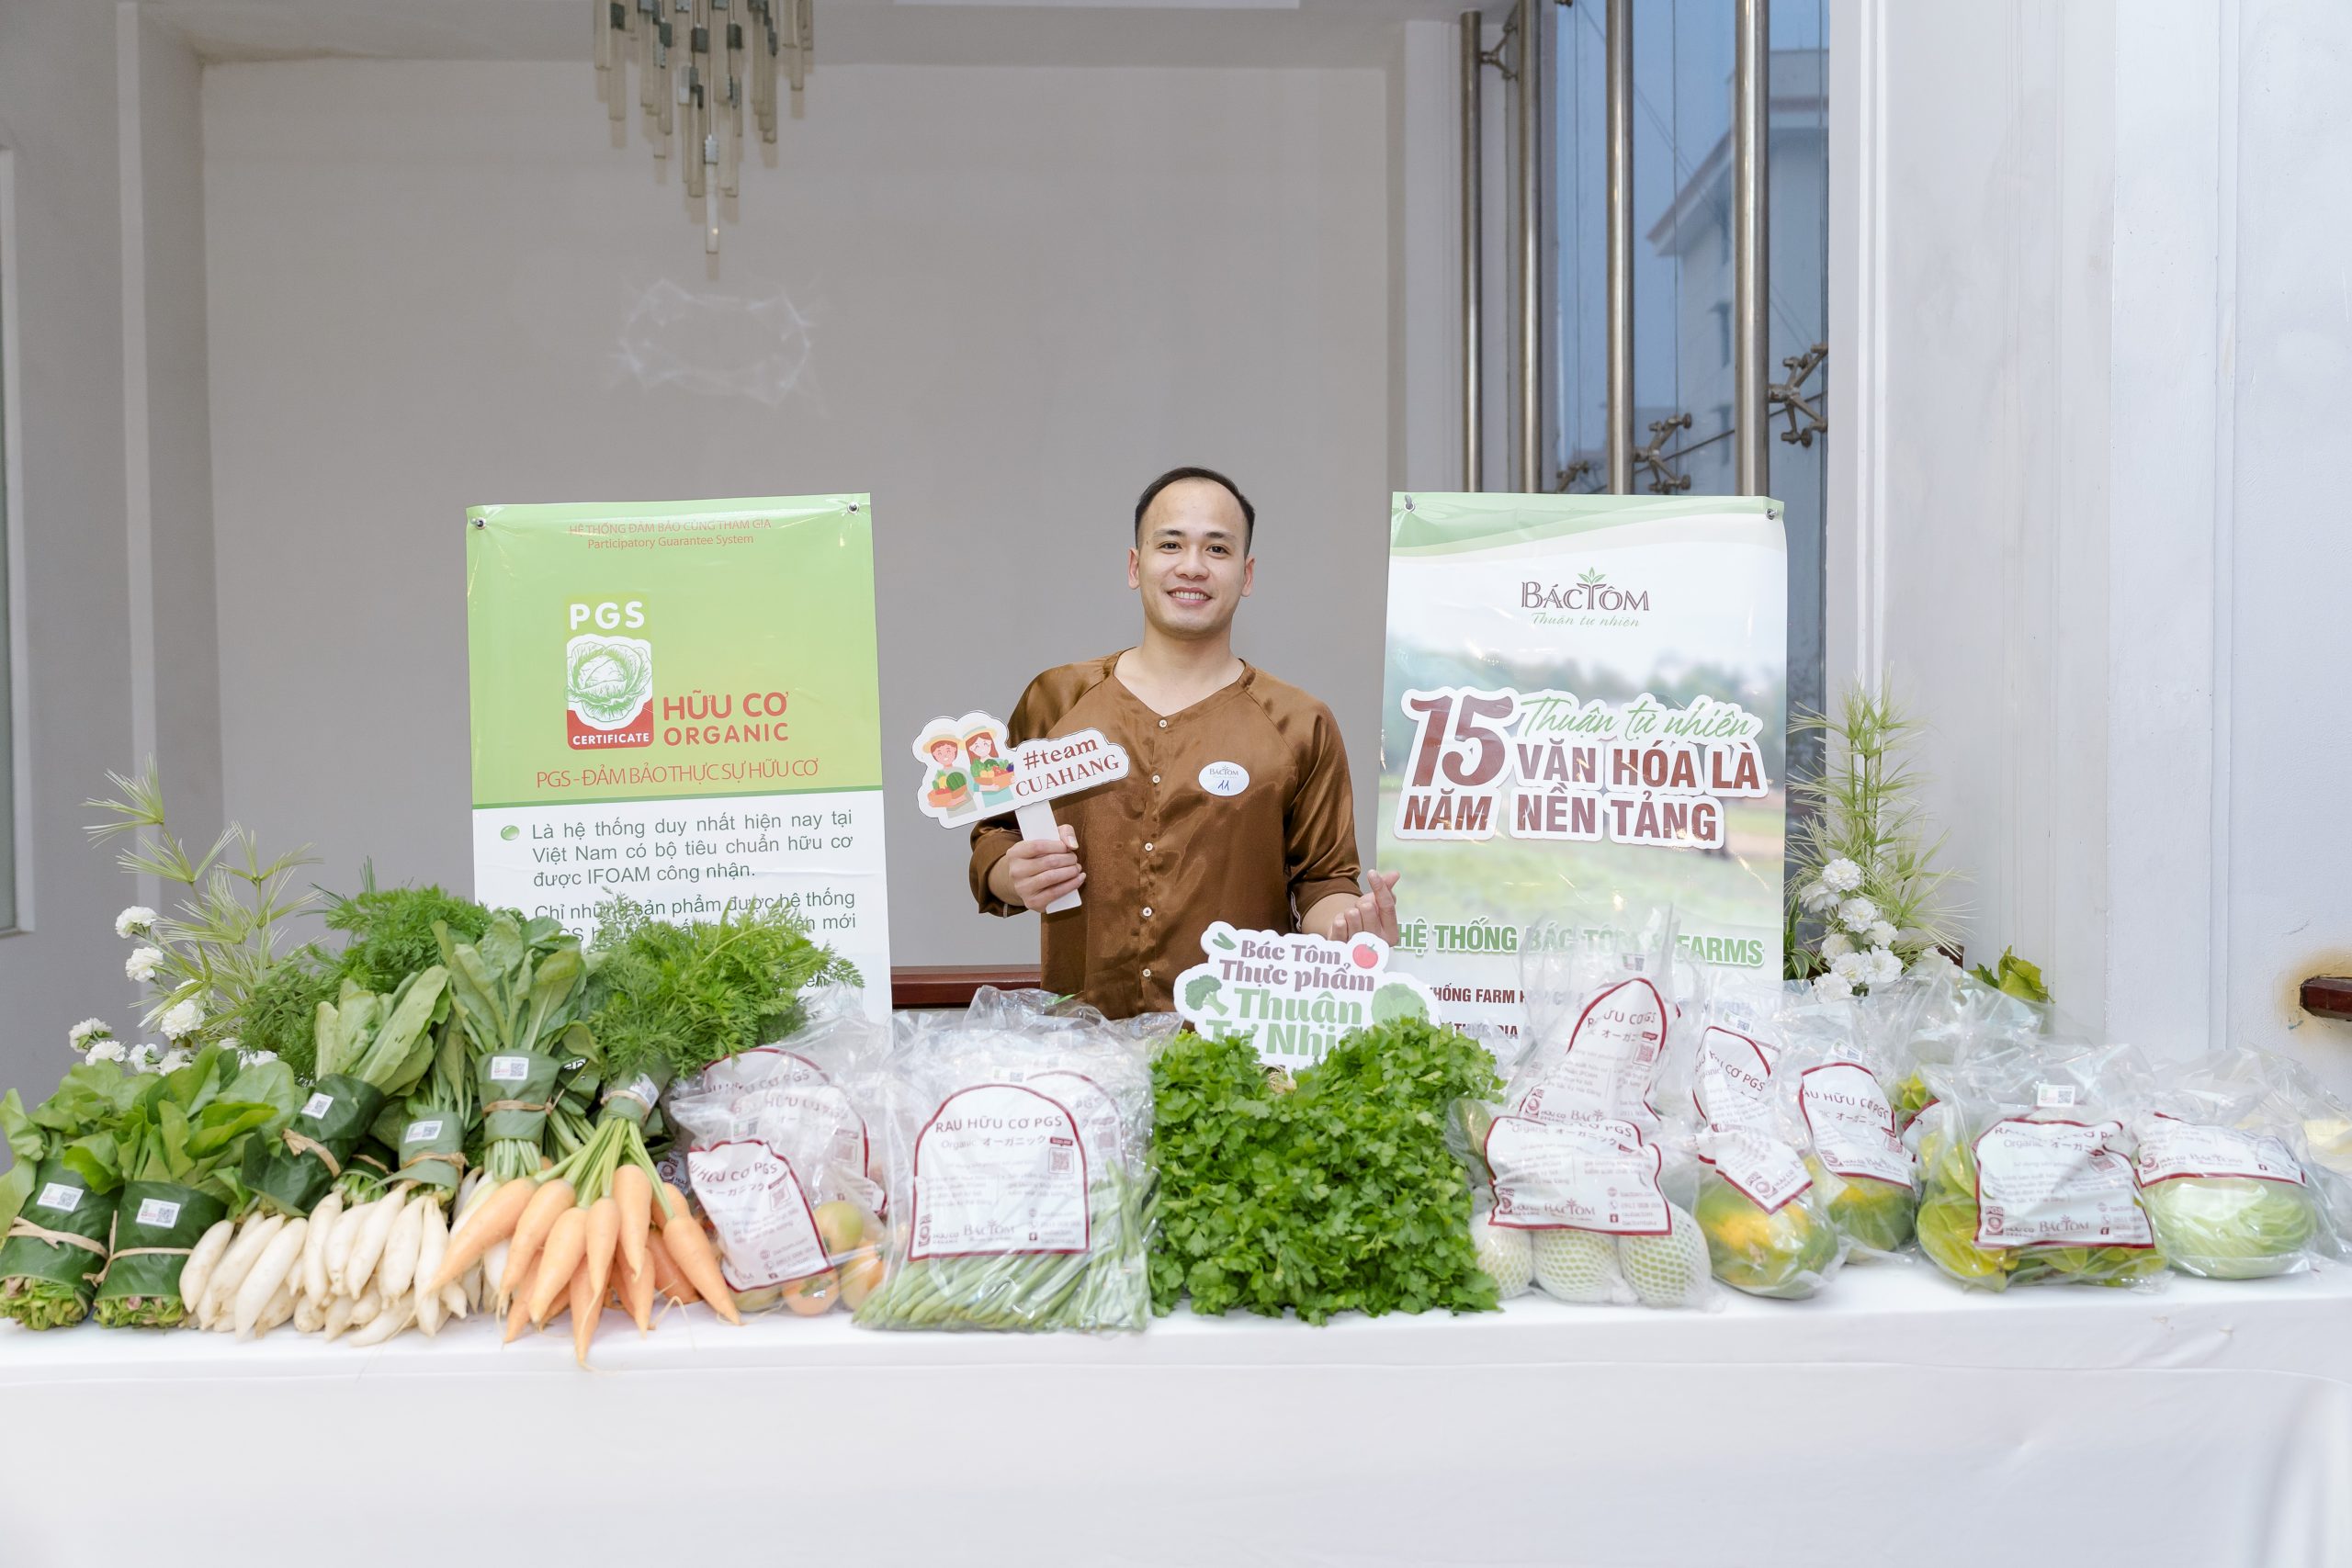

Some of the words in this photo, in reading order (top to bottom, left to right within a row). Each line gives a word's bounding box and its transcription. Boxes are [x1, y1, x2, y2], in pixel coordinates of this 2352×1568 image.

[718, 519, 750, 530] THAM
[752, 518, 772, 529] GIA
[588, 536, 655, 551] Participatory
[658, 536, 714, 547] Guarantee
[716, 535, 753, 547] System
[570, 601, 645, 631] PGS
[662, 689, 732, 721] HỮU
[742, 691, 789, 717] CƠ
[1521, 695, 1618, 741] Thuận
[1624, 700, 1658, 742] tự
[1666, 701, 1754, 738] nhiên
[572, 732, 650, 746] CERTIFICATE
[663, 722, 789, 747] ORGANIC
[1410, 694, 1514, 788] 15
[1023, 736, 1099, 771] #team
[1517, 739, 1597, 784] VĂN
[1612, 740, 1698, 789] HÓA
[1712, 741, 1760, 790] LÀ
[582, 763, 627, 787] ĐẢM
[629, 761, 667, 784] BẢO
[668, 761, 719, 785] THỰC
[721, 761, 746, 784] SỰ
[749, 758, 789, 779] HỮU
[792, 758, 820, 777] CƠ
[1015, 753, 1120, 797] CUAHANG
[532, 824, 554, 840] Là
[564, 822, 585, 840] hệ
[595, 817, 645, 839] thống
[655, 818, 687, 837] duy
[696, 812, 736, 831] nhất
[745, 814, 781, 831] hiện
[791, 814, 822, 829] nay
[831, 809, 853, 828] tại
[1403, 788, 1490, 831] NĂM
[1517, 782, 1597, 834] NỀN
[1611, 790, 1717, 842] TẢNG
[532, 846, 568, 865] Việt
[575, 845, 617, 861] Nam
[626, 842, 647, 859] có
[655, 841, 677, 860] bộ
[685, 840, 717, 856] tiêu
[726, 833, 780, 854] chuẩn
[788, 835, 822, 851] hữu
[831, 836, 854, 849] cơ
[533, 872, 582, 889] được
[588, 866, 650, 885] IFOAM
[657, 864, 700, 883] công
[707, 862, 755, 881] nhận.
[535, 903, 565, 919] Chỉ
[635, 899, 666, 917] sản
[672, 894, 721, 919] phẩm
[727, 896, 775, 913] được
[780, 891, 800, 911] hệ
[806, 886, 855, 908] thống
[823, 913, 856, 930] mới
[1240, 940, 1285, 961] Bác
[1291, 943, 1341, 965] Tôm
[1397, 919, 1428, 954] HỆ
[1434, 917, 1518, 952] THỐNG
[1677, 934, 1764, 967] FARMS
[1219, 959, 1287, 987] Thực
[1295, 963, 1374, 993] phẩm
[1234, 987, 1363, 1029] Thuận
[1430, 983, 1472, 1002] HỐNG
[1476, 988, 1515, 1004] FARM
[1724, 1064, 1743, 1078] CƠ
[1742, 1073, 1767, 1092] PGS
[1823, 1091, 1856, 1106] HỮU
[935, 1118, 963, 1134] RAU
[967, 1114, 1003, 1130] HỮU
[1008, 1116, 1030, 1130] CƠ
[1034, 1115, 1063, 1130] PGS
[941, 1139, 976, 1151] Organic
[982, 1134, 1047, 1147] オーガニック
[754, 1161, 778, 1176] PGS
